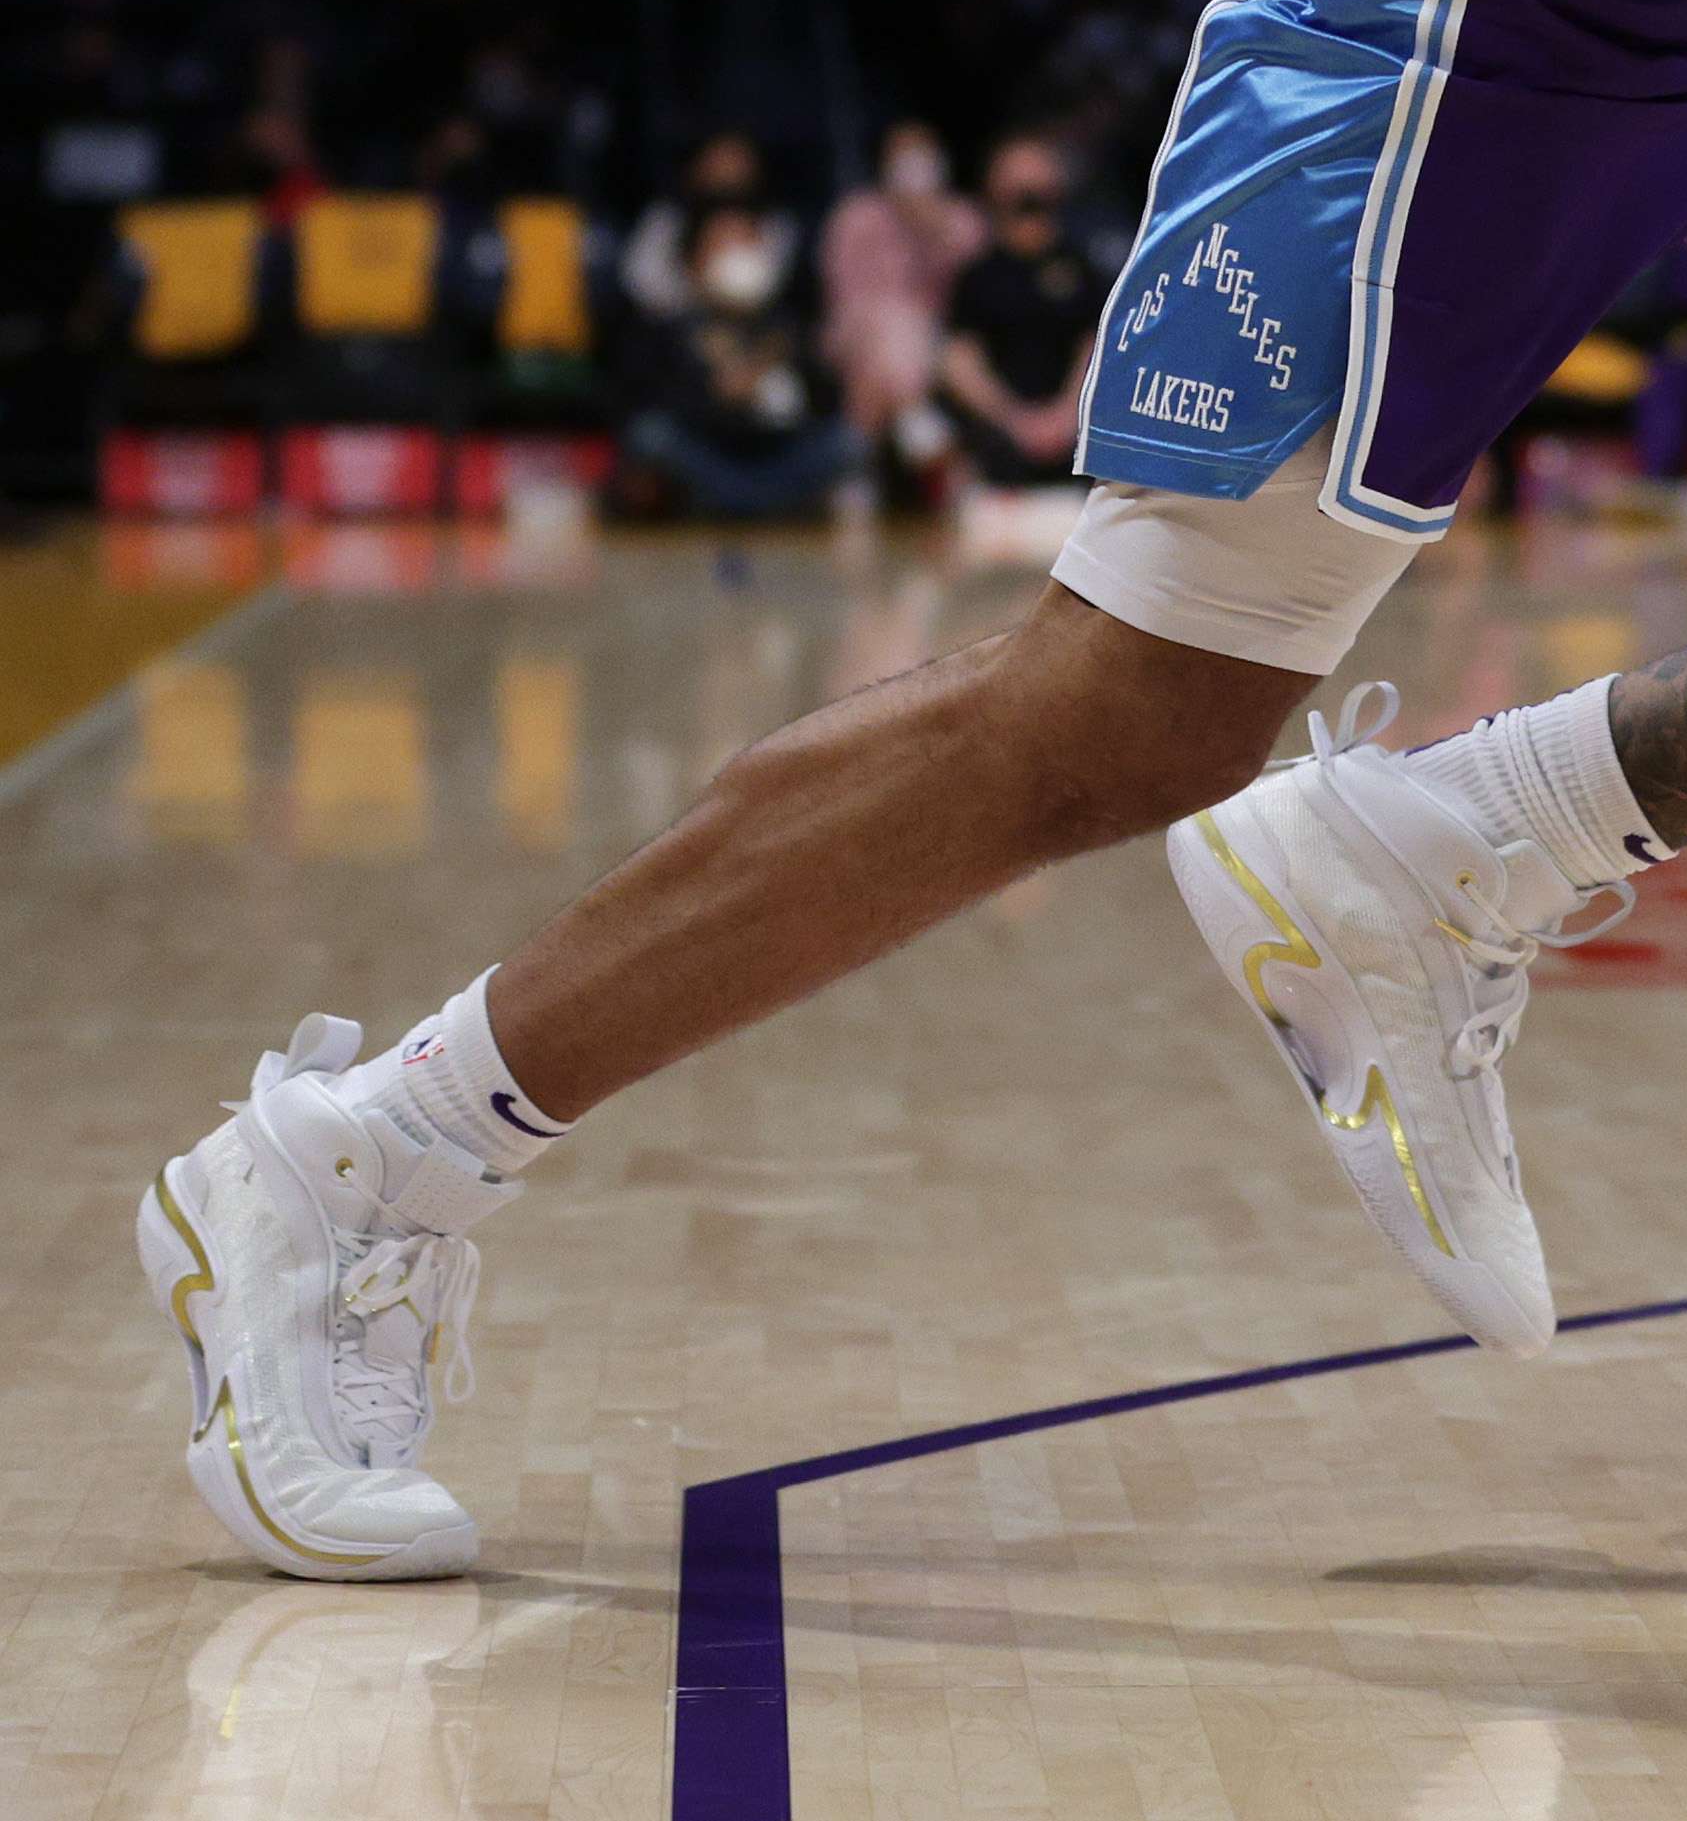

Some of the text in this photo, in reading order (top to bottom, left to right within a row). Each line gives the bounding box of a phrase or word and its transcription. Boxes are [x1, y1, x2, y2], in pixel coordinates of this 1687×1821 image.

[1117, 223, 1297, 391] LOS ANGELES
[1130, 366, 1235, 434] LAKERS
